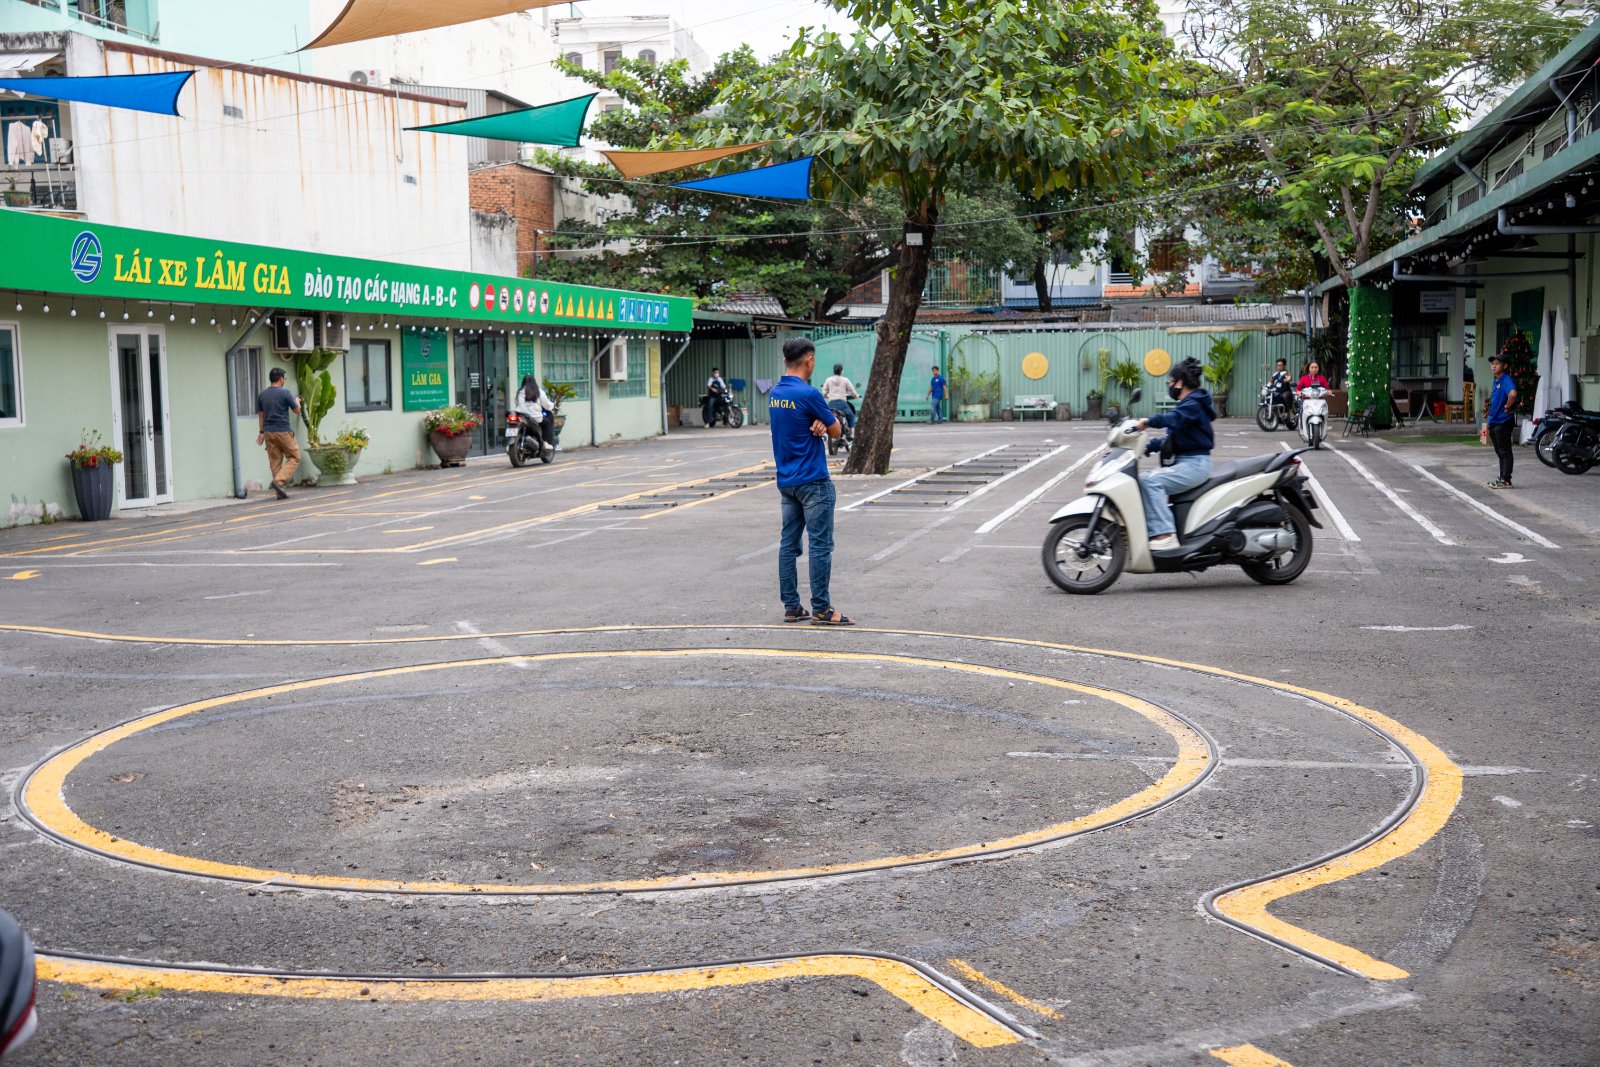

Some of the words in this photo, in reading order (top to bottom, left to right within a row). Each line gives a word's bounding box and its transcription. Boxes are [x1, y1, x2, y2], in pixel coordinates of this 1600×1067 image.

[114, 248, 153, 284] LÁI
[158, 259, 188, 287] XE
[195, 249, 247, 292] LÂM
[253, 262, 292, 295] GIA
[304, 267, 333, 298] ĐÀO
[337, 276, 362, 308] TẠO
[364, 273, 389, 303] CÁC
[391, 281, 421, 309] HẠNG
[411, 370, 427, 386] LÂM
[428, 372, 442, 386] GIA
[769, 396, 780, 408] ÂM
[780, 399, 797, 410] GIA
